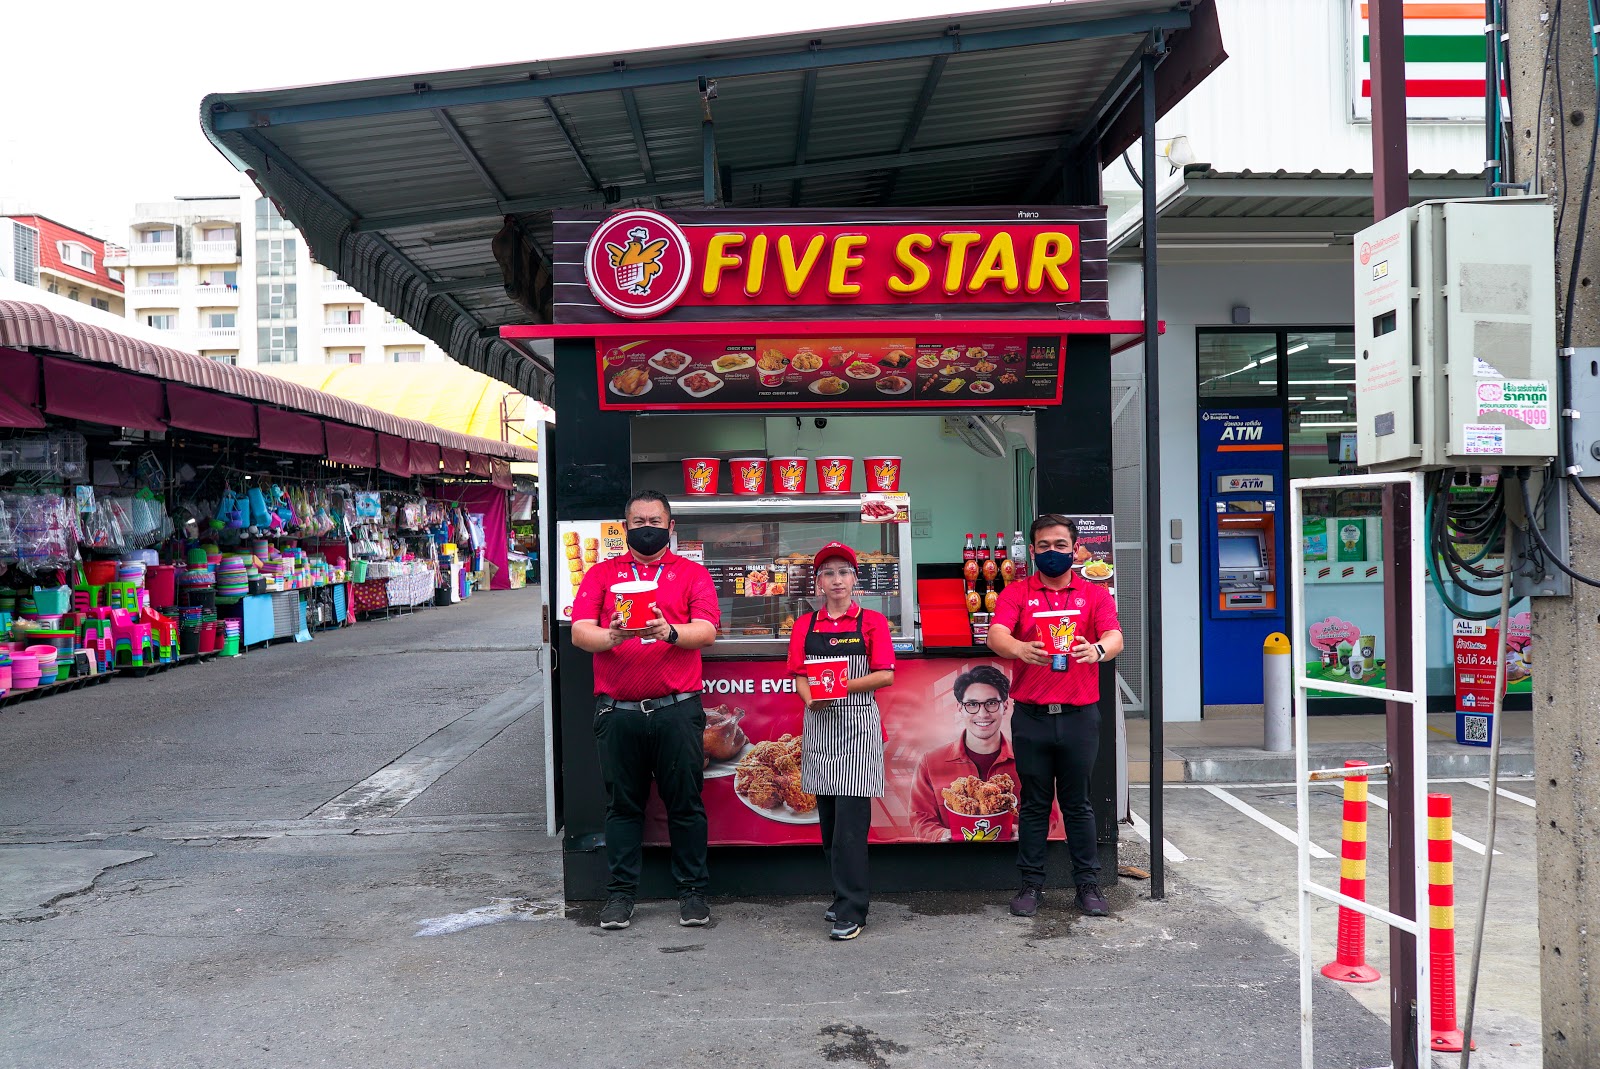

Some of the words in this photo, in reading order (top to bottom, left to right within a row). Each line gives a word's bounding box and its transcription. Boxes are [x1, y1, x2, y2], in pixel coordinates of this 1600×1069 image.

[1017, 210, 1039, 218] ห้าดาว
[701, 234, 869, 295] FIVE
[887, 231, 1073, 293] STAR
[1503, 393, 1547, 404] ราคาถูก
[1220, 427, 1263, 440] ATM
[1240, 480, 1264, 489] ATM
[897, 511, 907, 520] 25
[1456, 621, 1473, 629] ALL
[1456, 653, 1478, 665] รับได้
[1480, 656, 1492, 665] 24
